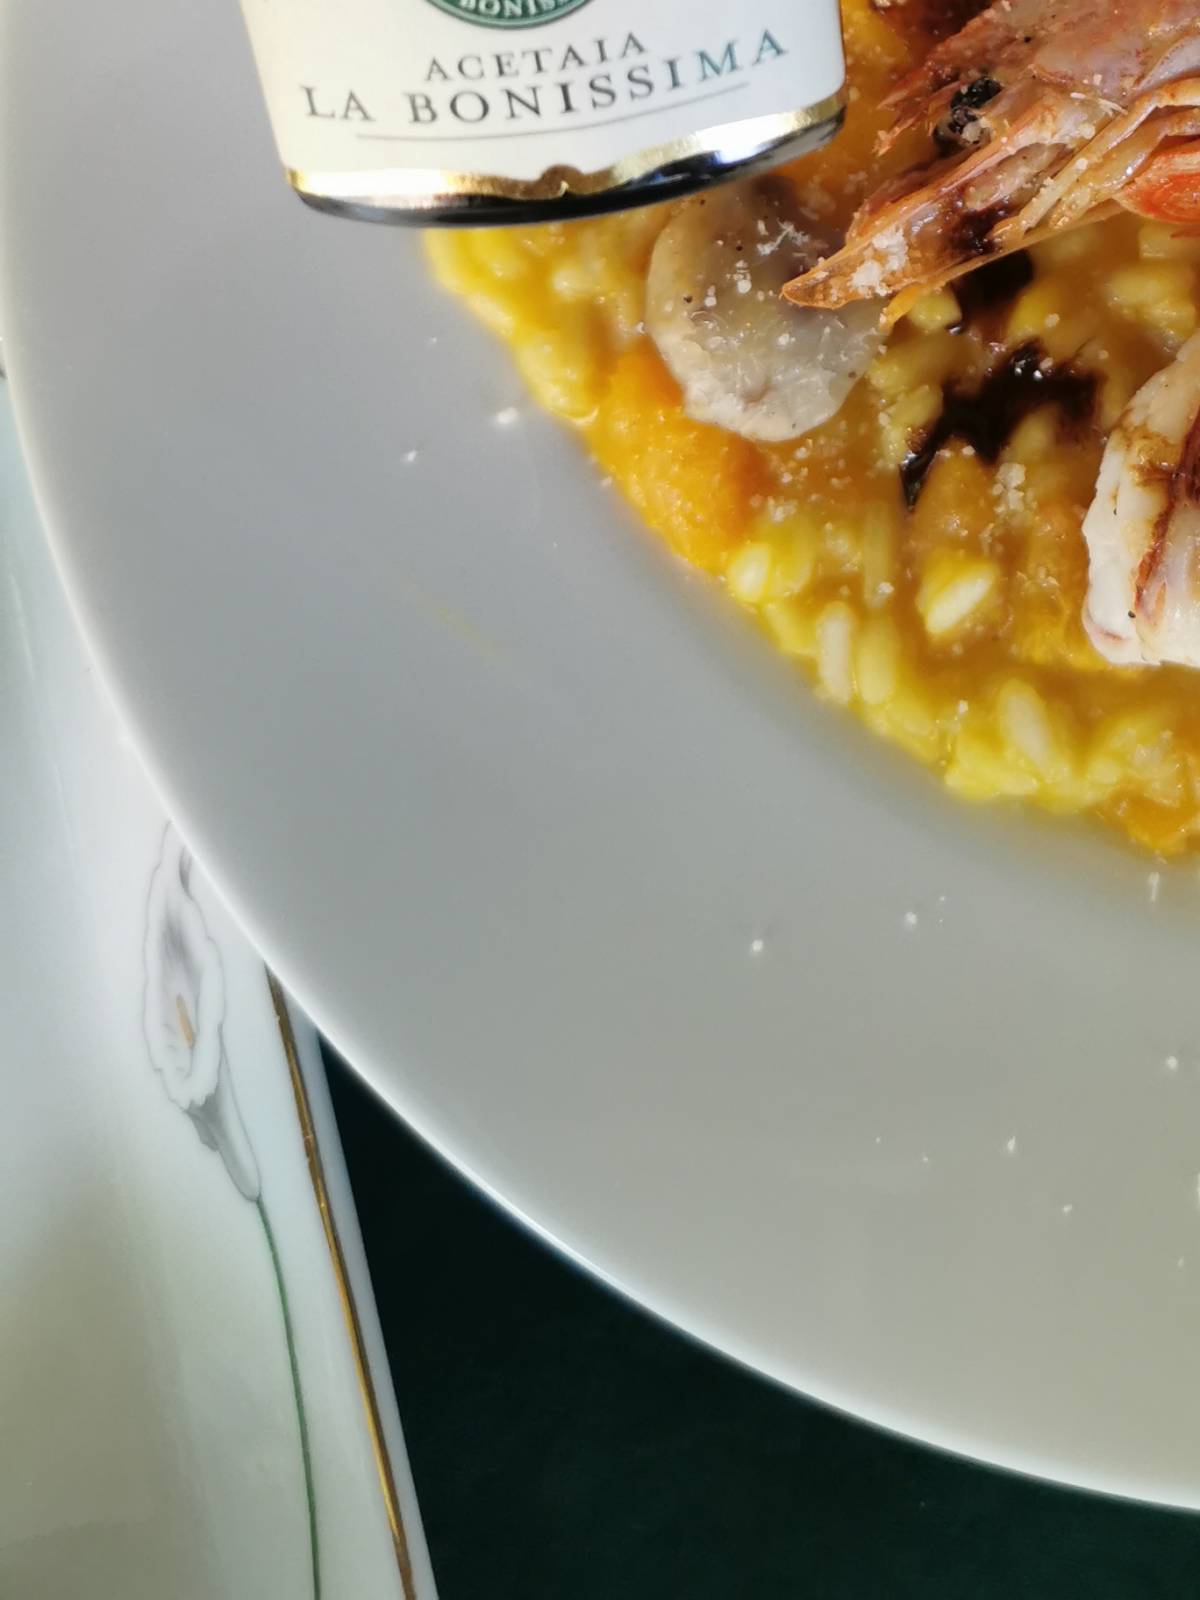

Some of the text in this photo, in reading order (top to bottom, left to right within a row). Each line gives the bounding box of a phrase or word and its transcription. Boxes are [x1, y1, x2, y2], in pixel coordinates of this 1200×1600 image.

[299, 29, 789, 125] LA BONISSIMA
[424, 32, 648, 82] ACETAIA
